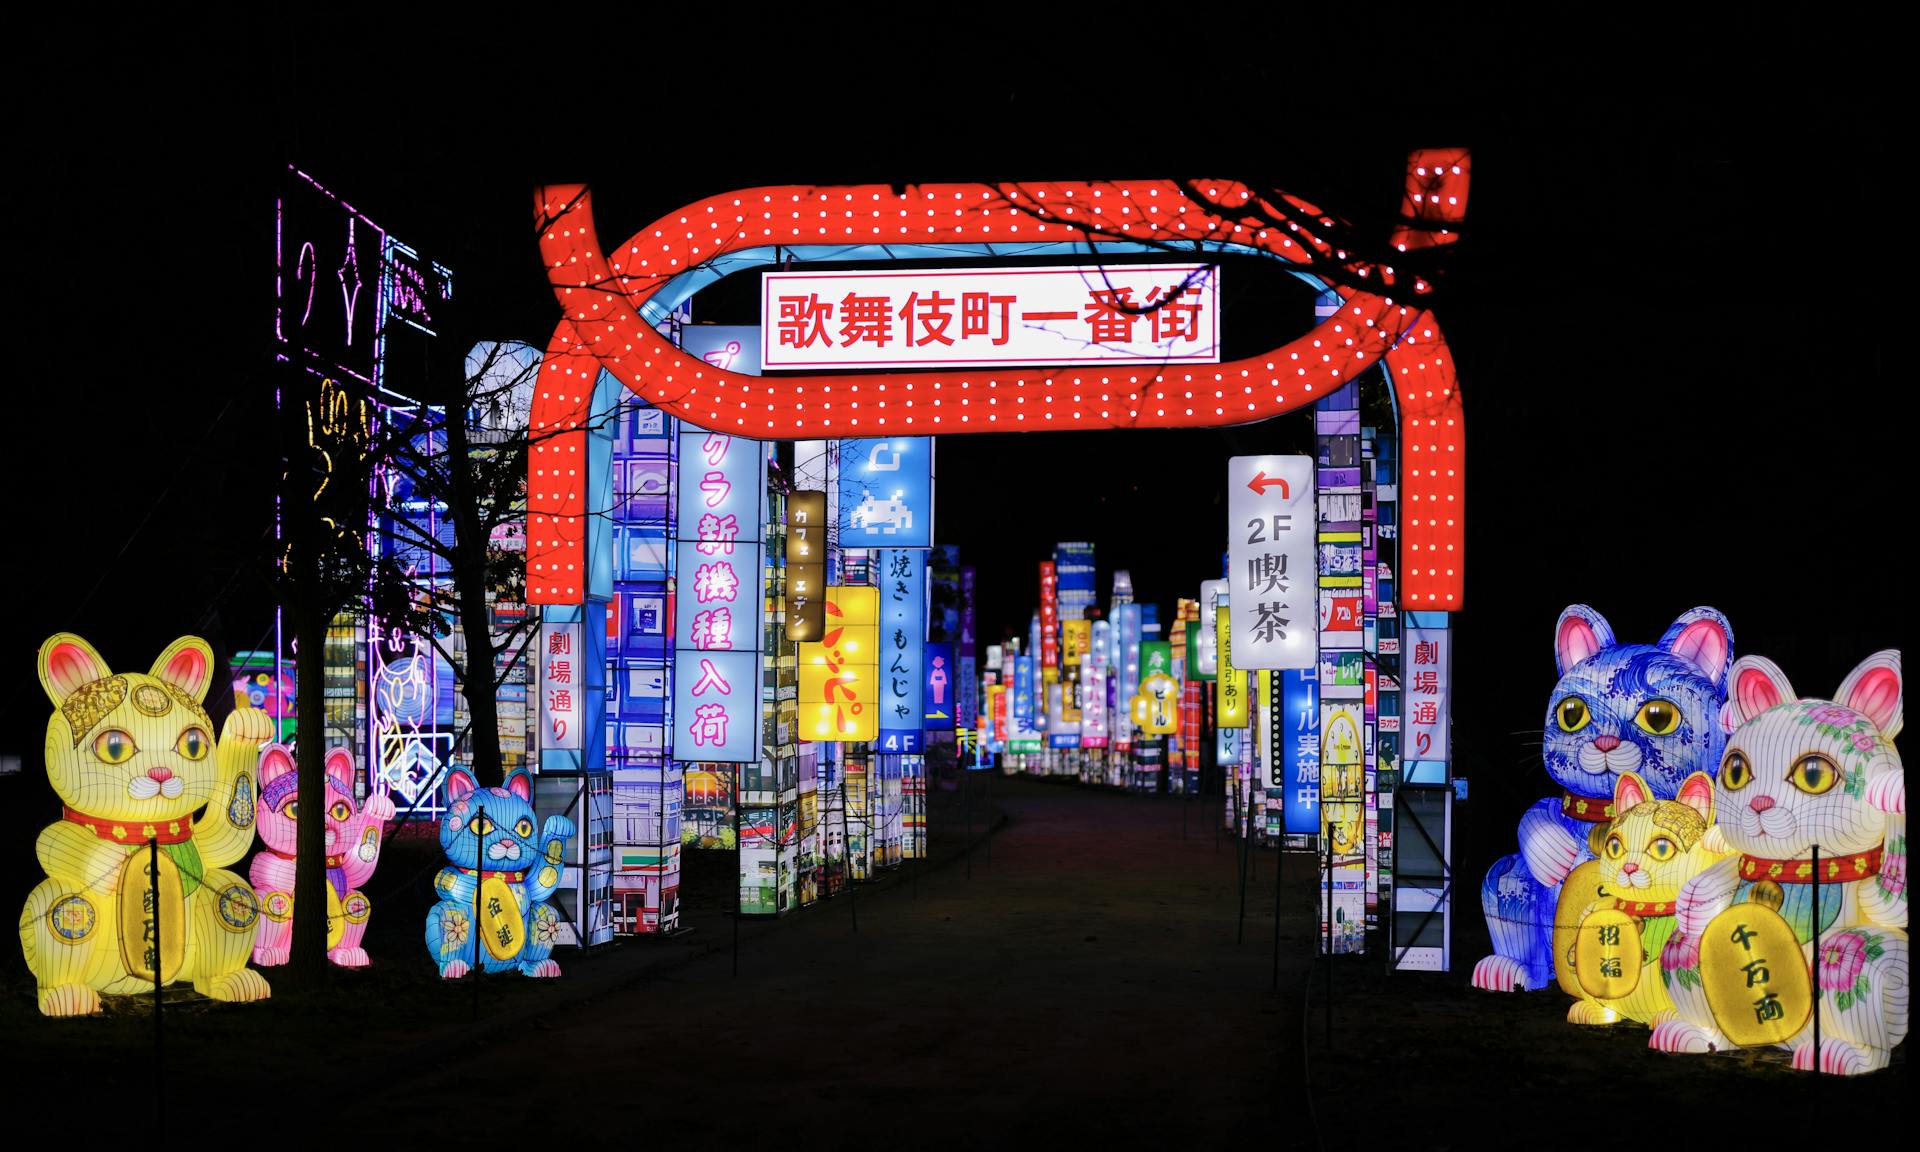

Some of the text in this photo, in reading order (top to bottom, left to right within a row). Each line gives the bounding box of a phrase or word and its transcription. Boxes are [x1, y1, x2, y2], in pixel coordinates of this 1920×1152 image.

[778, 288, 1203, 349] 歌舞伎町一番街
[690, 340, 741, 748] プクラ新機種入荷
[794, 509, 810, 628] カフェ・エデン
[1247, 515, 1292, 545] 2F
[1248, 553, 1291, 644] 喫茶
[548, 632, 573, 741] 劇場通り
[1154, 689, 1167, 726] ビール
[1412, 640, 1439, 756] 劇場通り
[885, 735, 911, 751] 4F
[1598, 925, 1622, 978] 招福
[1730, 923, 1785, 1025] 千万両
